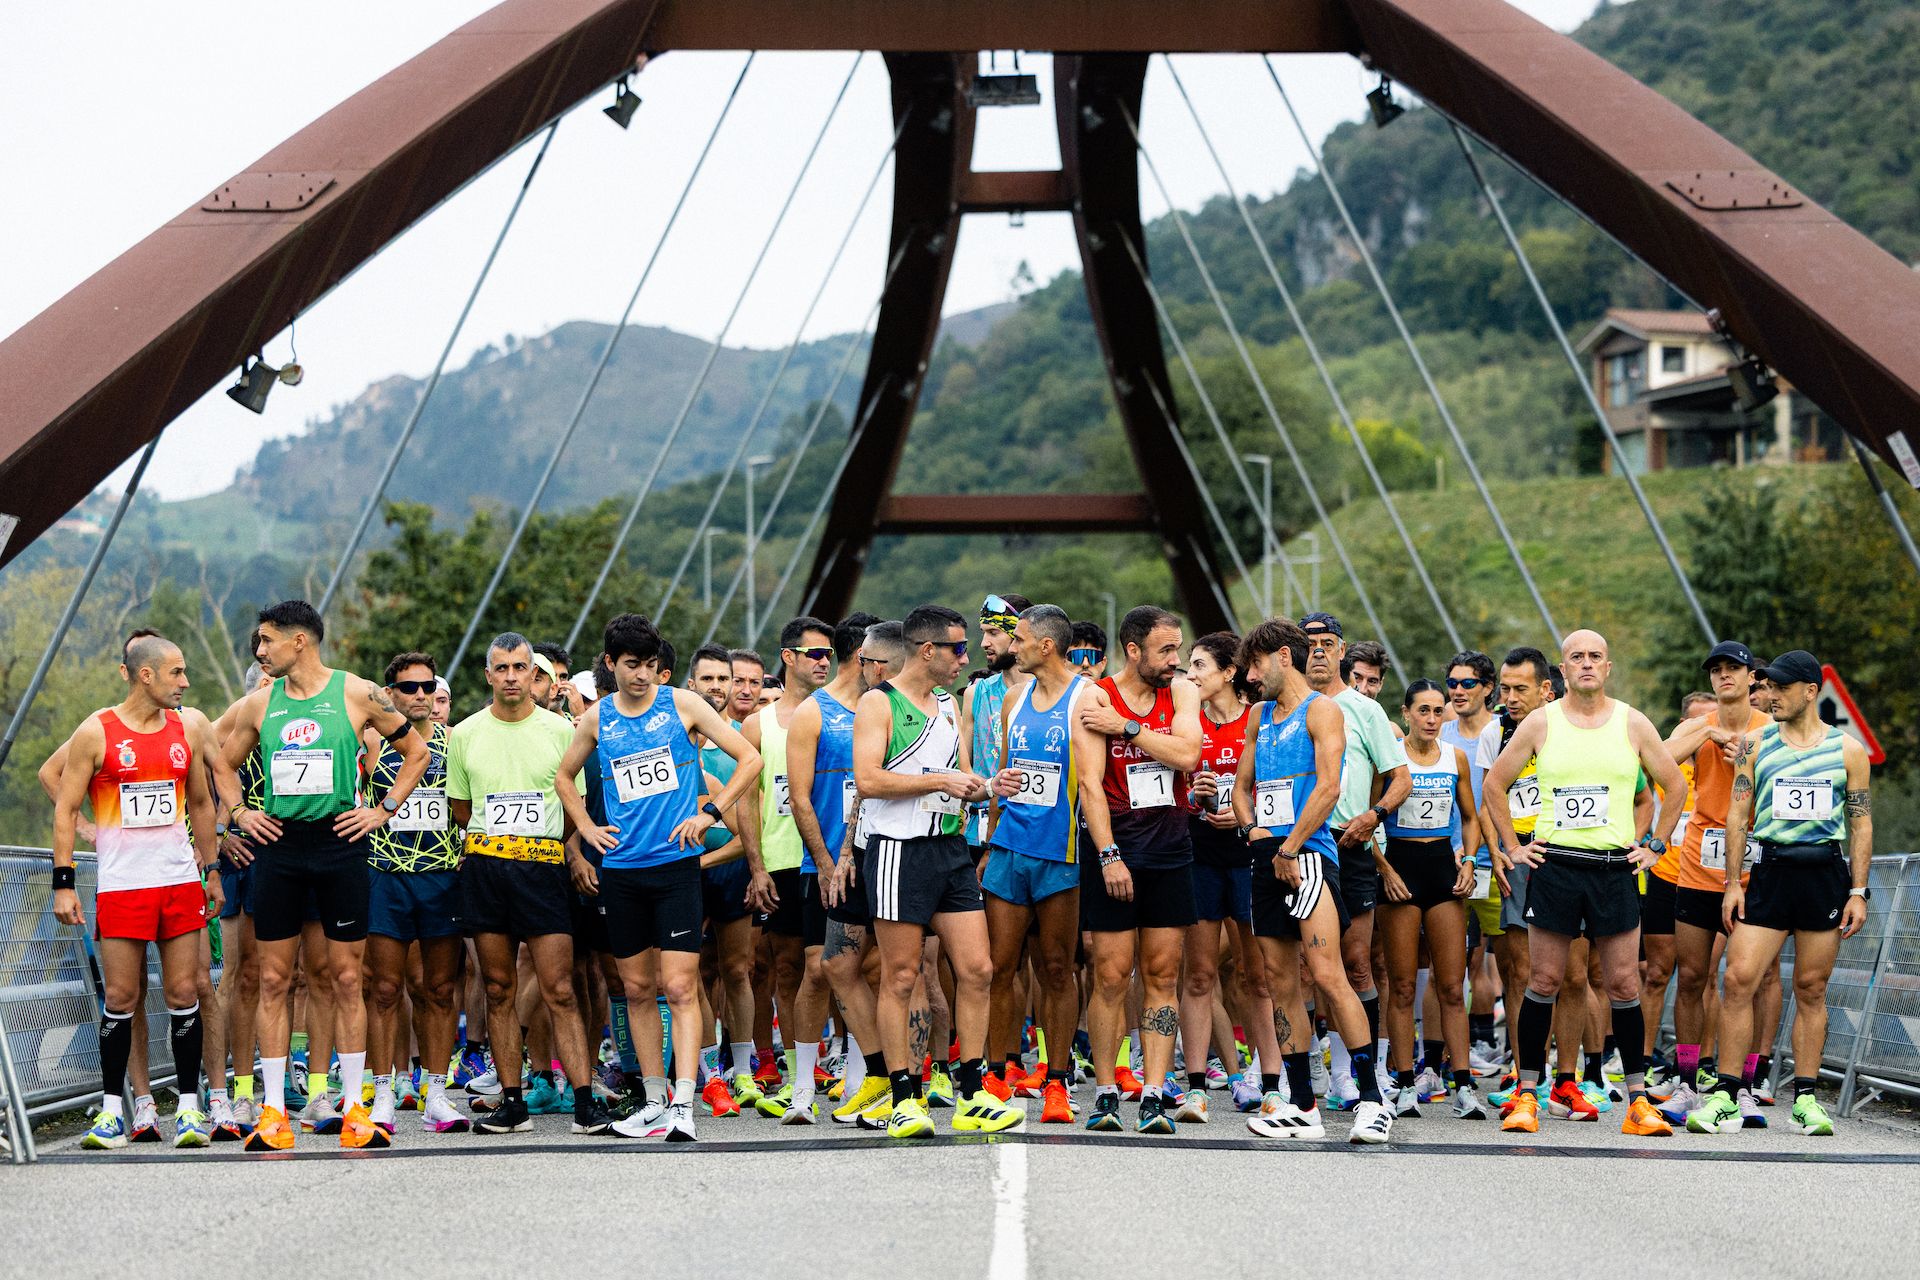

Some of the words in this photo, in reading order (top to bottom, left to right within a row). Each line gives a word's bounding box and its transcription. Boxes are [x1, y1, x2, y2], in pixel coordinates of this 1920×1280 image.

[295, 763, 308, 783] 7
[623, 761, 669, 789] 156
[1413, 775, 1452, 787] élagoS
[1020, 772, 1044, 795] 93
[1154, 774, 1164, 794] 1
[130, 794, 172, 816] 175
[1220, 788, 1231, 806] 4
[1264, 795, 1274, 815] 3
[1789, 790, 1815, 810] 31
[398, 800, 440, 820] 316
[494, 804, 539, 824] 275
[1420, 801, 1433, 819] 2
[1566, 797, 1596, 818] 92
[1710, 840, 1752, 861] 12
